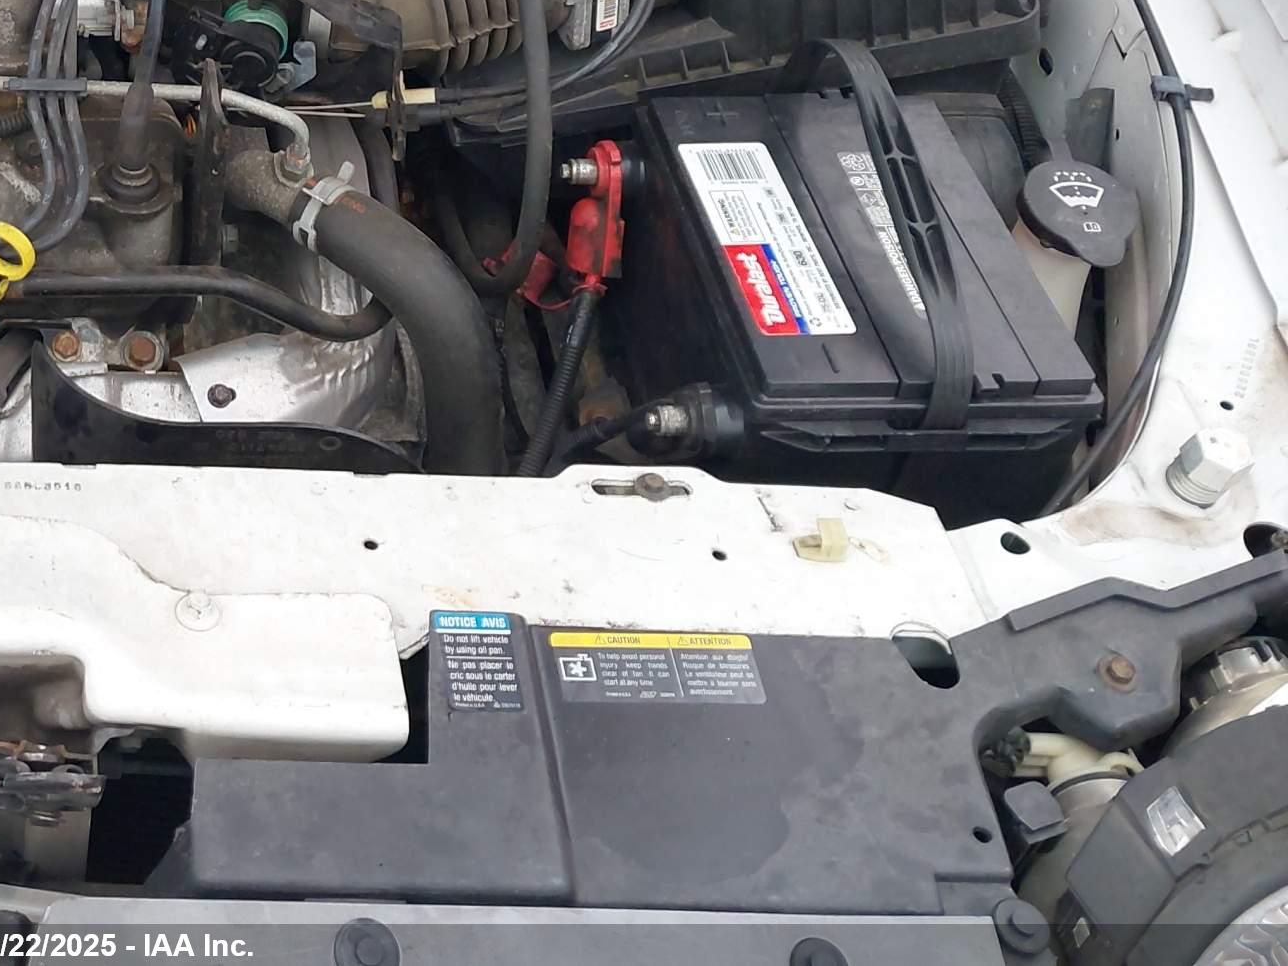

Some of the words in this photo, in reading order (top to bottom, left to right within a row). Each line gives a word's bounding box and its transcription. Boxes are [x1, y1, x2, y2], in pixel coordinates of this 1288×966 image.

[793, 250, 808, 266] 630
[735, 251, 787, 327] Duralast
[781, 286, 804, 319] PROVEN
[439, 616, 477, 627] NOTICE
[481, 617, 506, 627] AVIS
[444, 634, 454, 642] Do
[471, 635, 480, 643] lift
[483, 635, 508, 644] vehicle
[607, 636, 641, 644] CAUTION
[689, 637, 732, 645] ATTENTION
[445, 645, 454, 654] by
[457, 646, 476, 654] using
[448, 660, 458, 668] Ne
[480, 661, 502, 670] placer
[507, 661, 513, 669] le
[500, 683, 517, 691] lever
[454, 693, 460, 701] le
